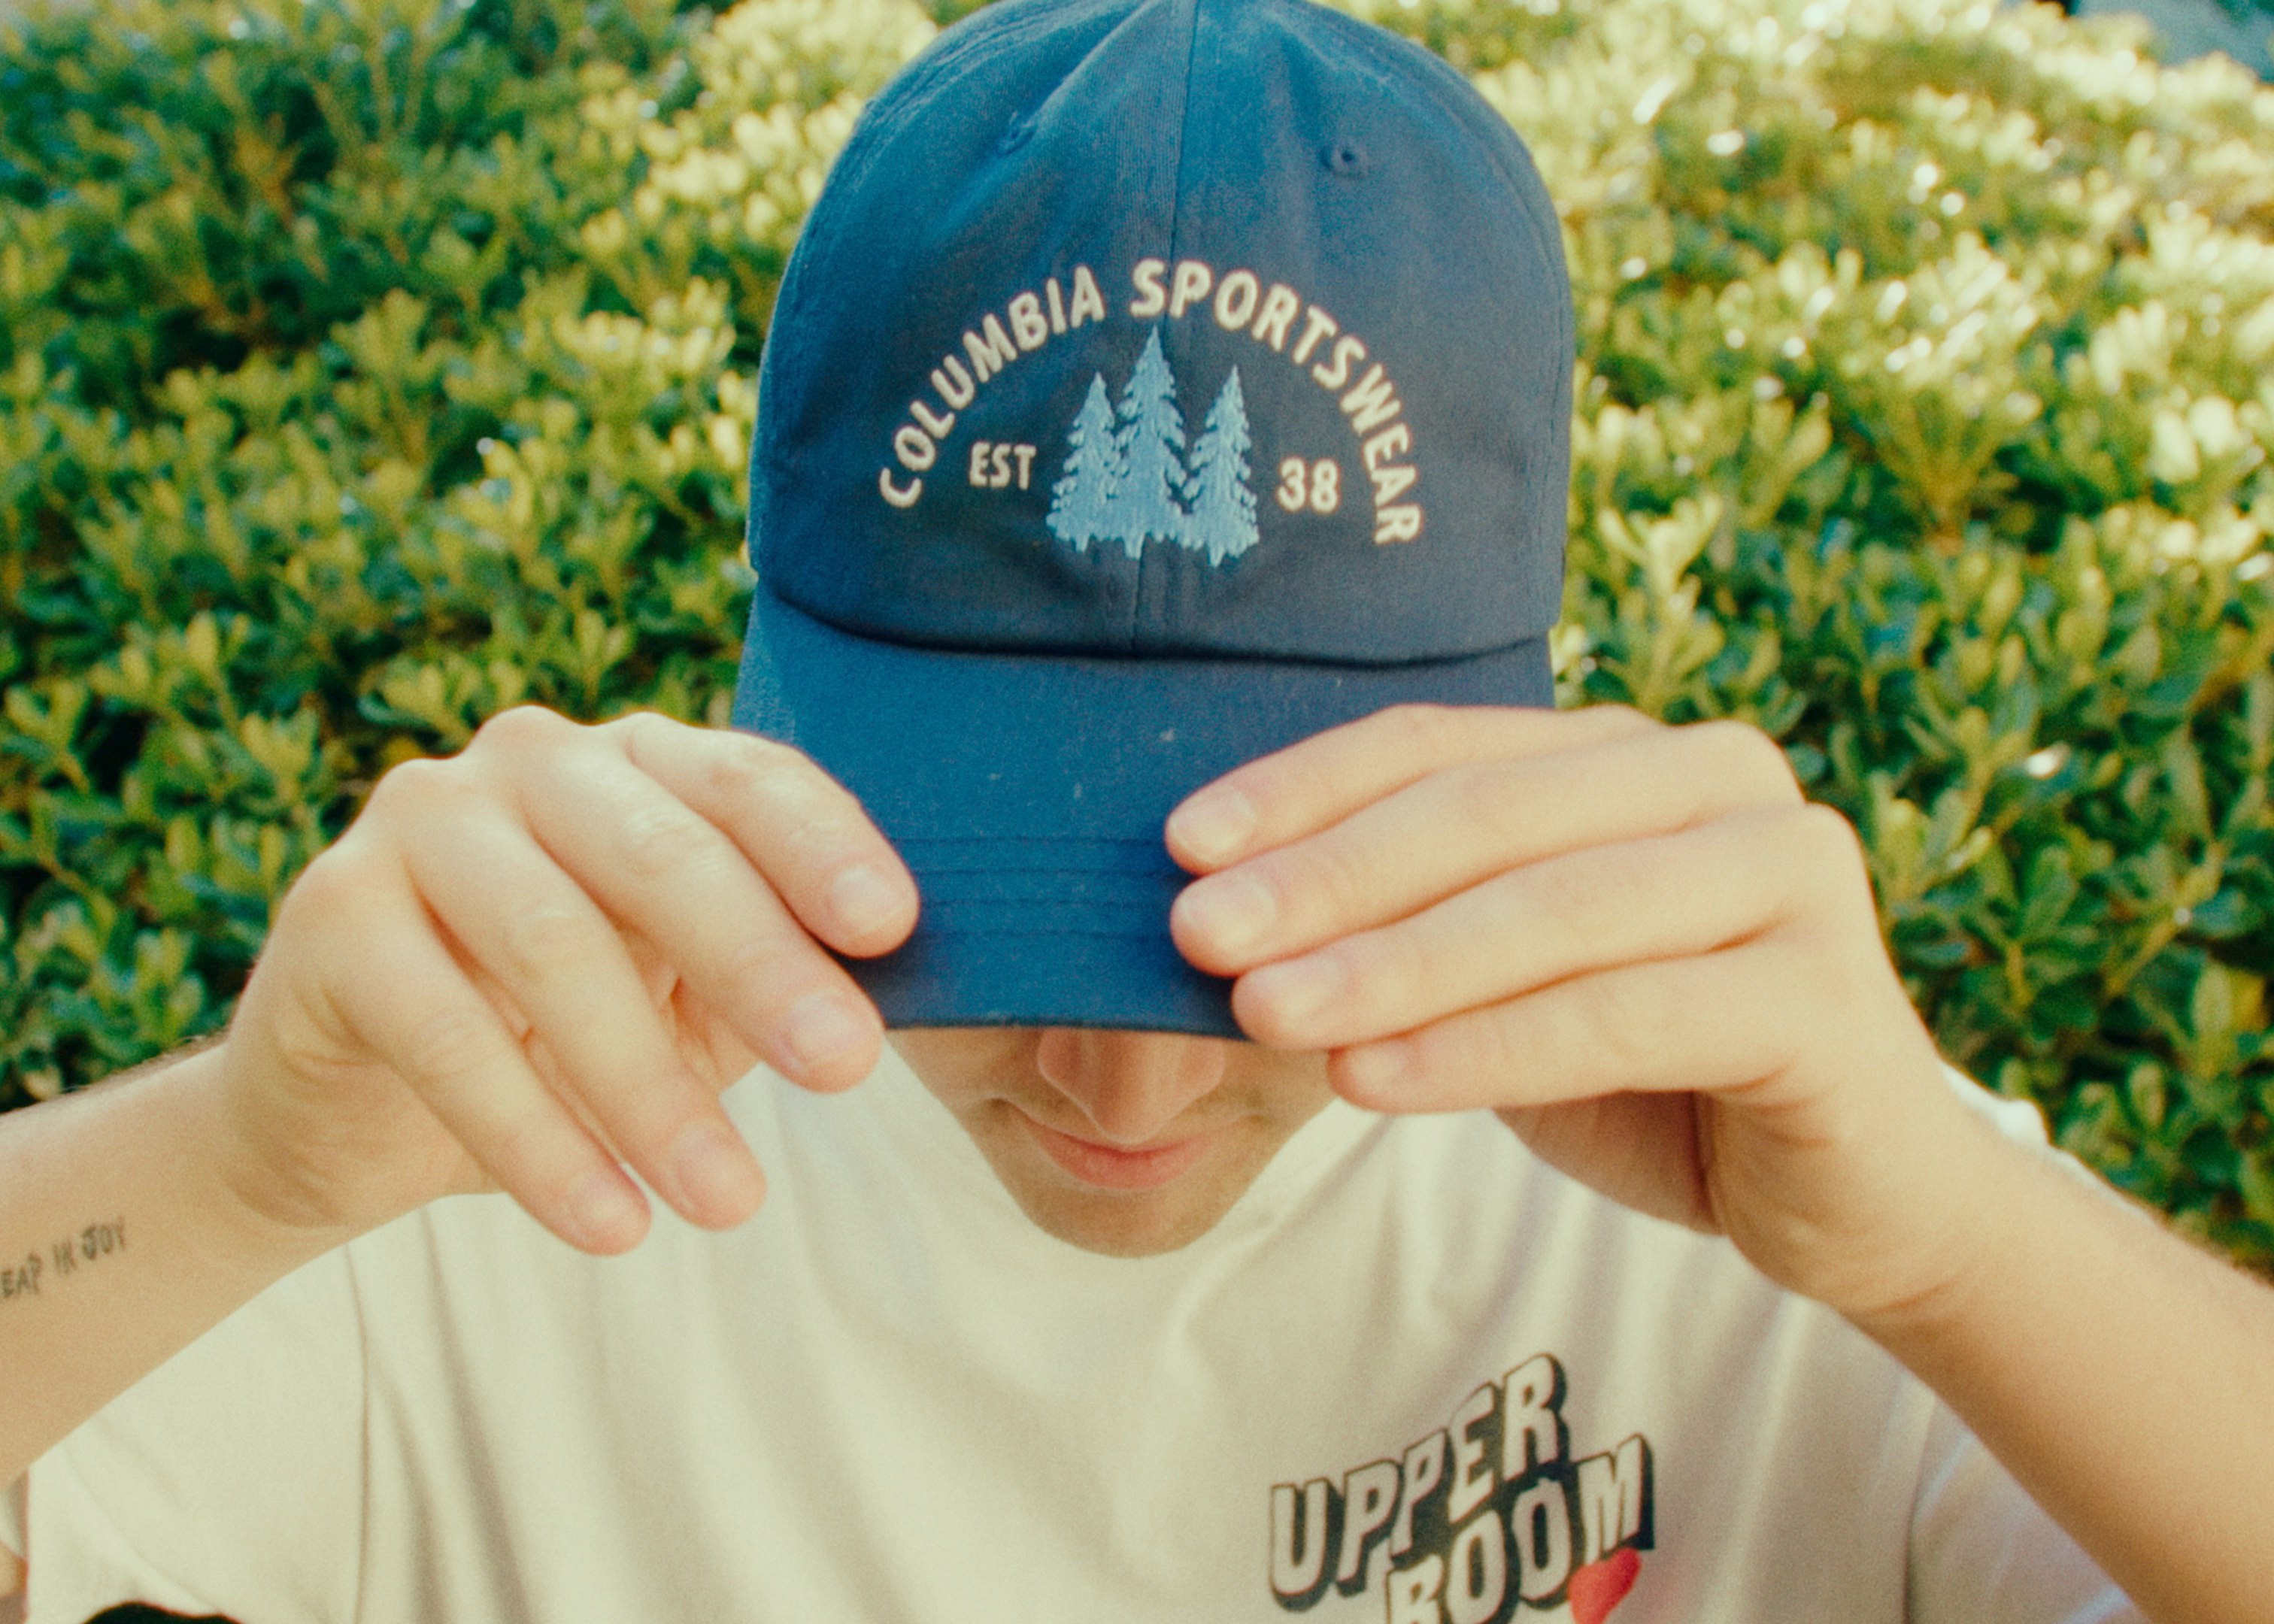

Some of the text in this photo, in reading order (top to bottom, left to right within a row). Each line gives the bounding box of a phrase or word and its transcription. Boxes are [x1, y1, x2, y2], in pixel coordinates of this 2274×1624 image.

[879, 258, 1425, 546] COLUMBIA SPORTSWEAR
[968, 441, 1036, 490] EST
[1276, 456, 1341, 514] 38
[0, 1252, 42, 1300] EAP
[81, 1216, 126, 1261] JOY
[1270, 1353, 1567, 1611] UPPER
[1385, 1433, 1654, 1624] ROOM
